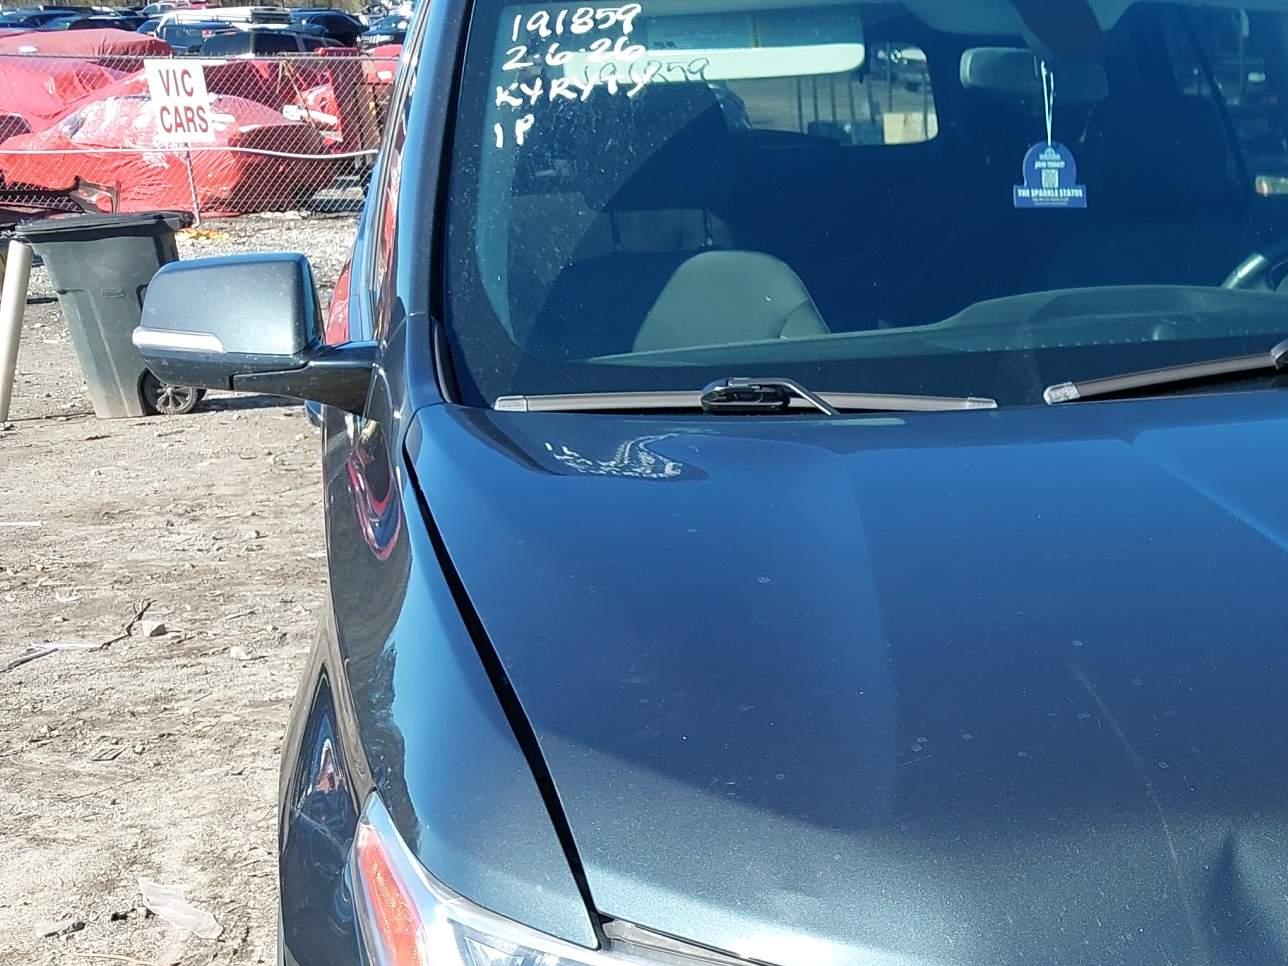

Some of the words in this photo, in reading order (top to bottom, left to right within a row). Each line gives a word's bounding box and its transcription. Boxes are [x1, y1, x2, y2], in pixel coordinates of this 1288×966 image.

[511, 3, 642, 41] 191859
[158, 69, 194, 97] VIC
[159, 105, 209, 133] CARS
